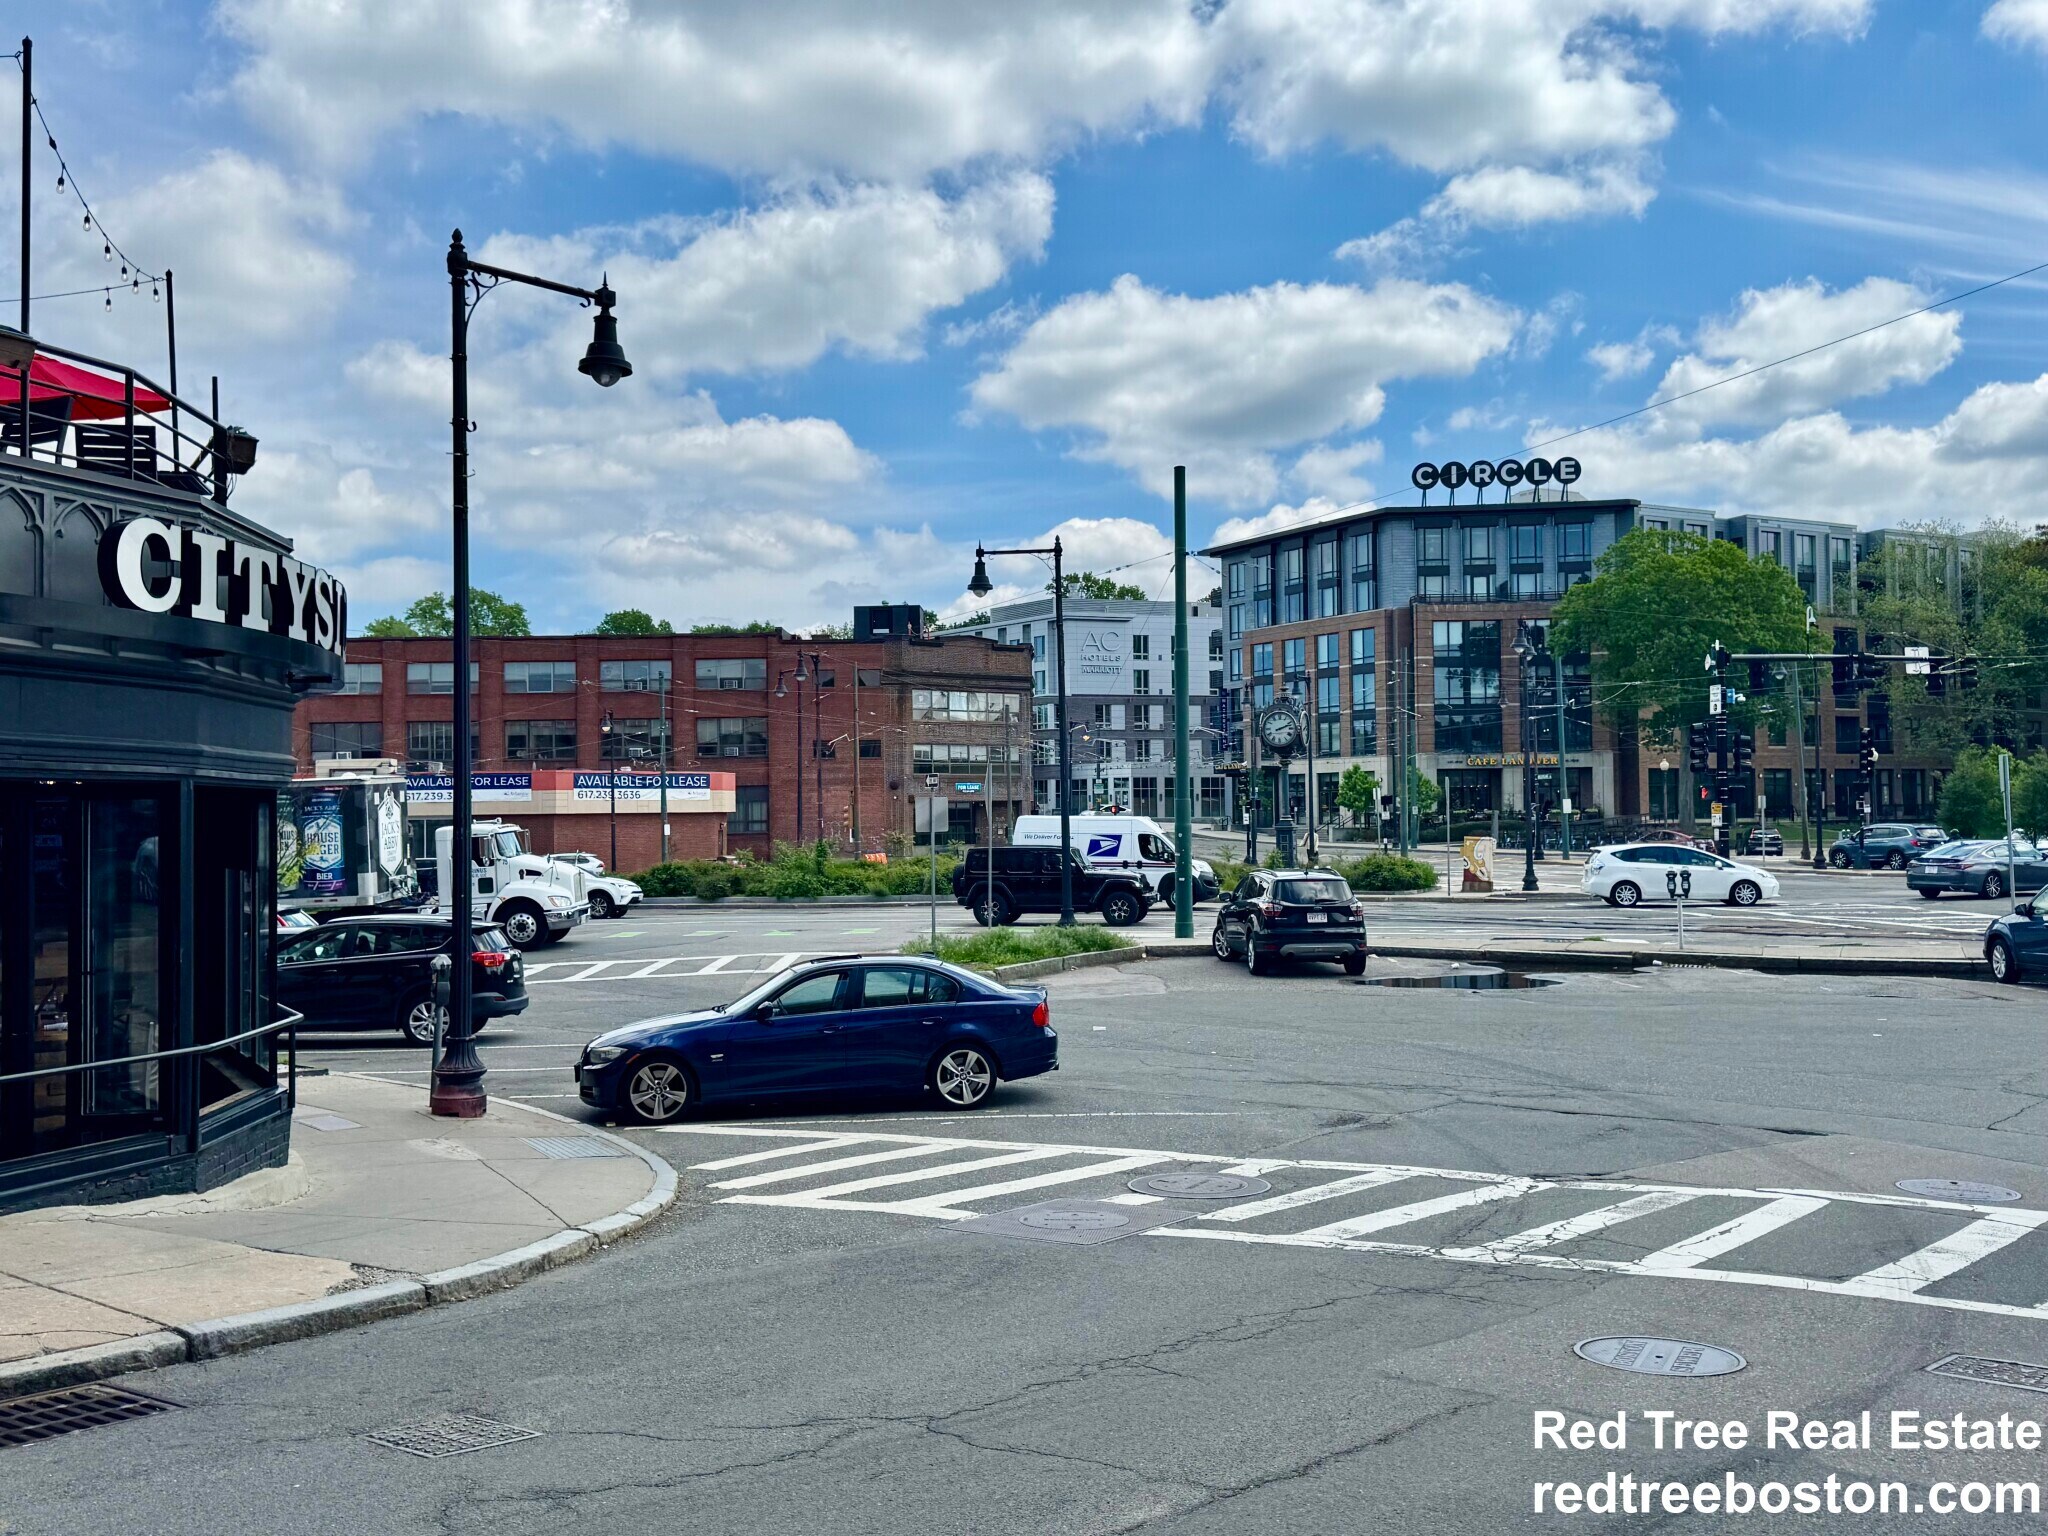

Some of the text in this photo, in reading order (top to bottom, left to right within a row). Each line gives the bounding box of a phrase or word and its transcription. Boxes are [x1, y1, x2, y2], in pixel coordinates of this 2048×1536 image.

[1415, 460, 1576, 485] CIRCLE
[116, 517, 346, 662] CITYSI
[1081, 630, 1121, 652] AC
[1081, 654, 1121, 662] HOTELS
[1081, 666, 1122, 675] MARRIOTT
[1467, 757, 1497, 766] CAFE
[494, 776, 529, 786] LEASE
[577, 775, 707, 787] AVAILABLE FOR LEASE
[577, 790, 641, 800] 617.239.3636
[307, 832, 339, 843] HOUSE
[316, 872, 333, 880] BIER
